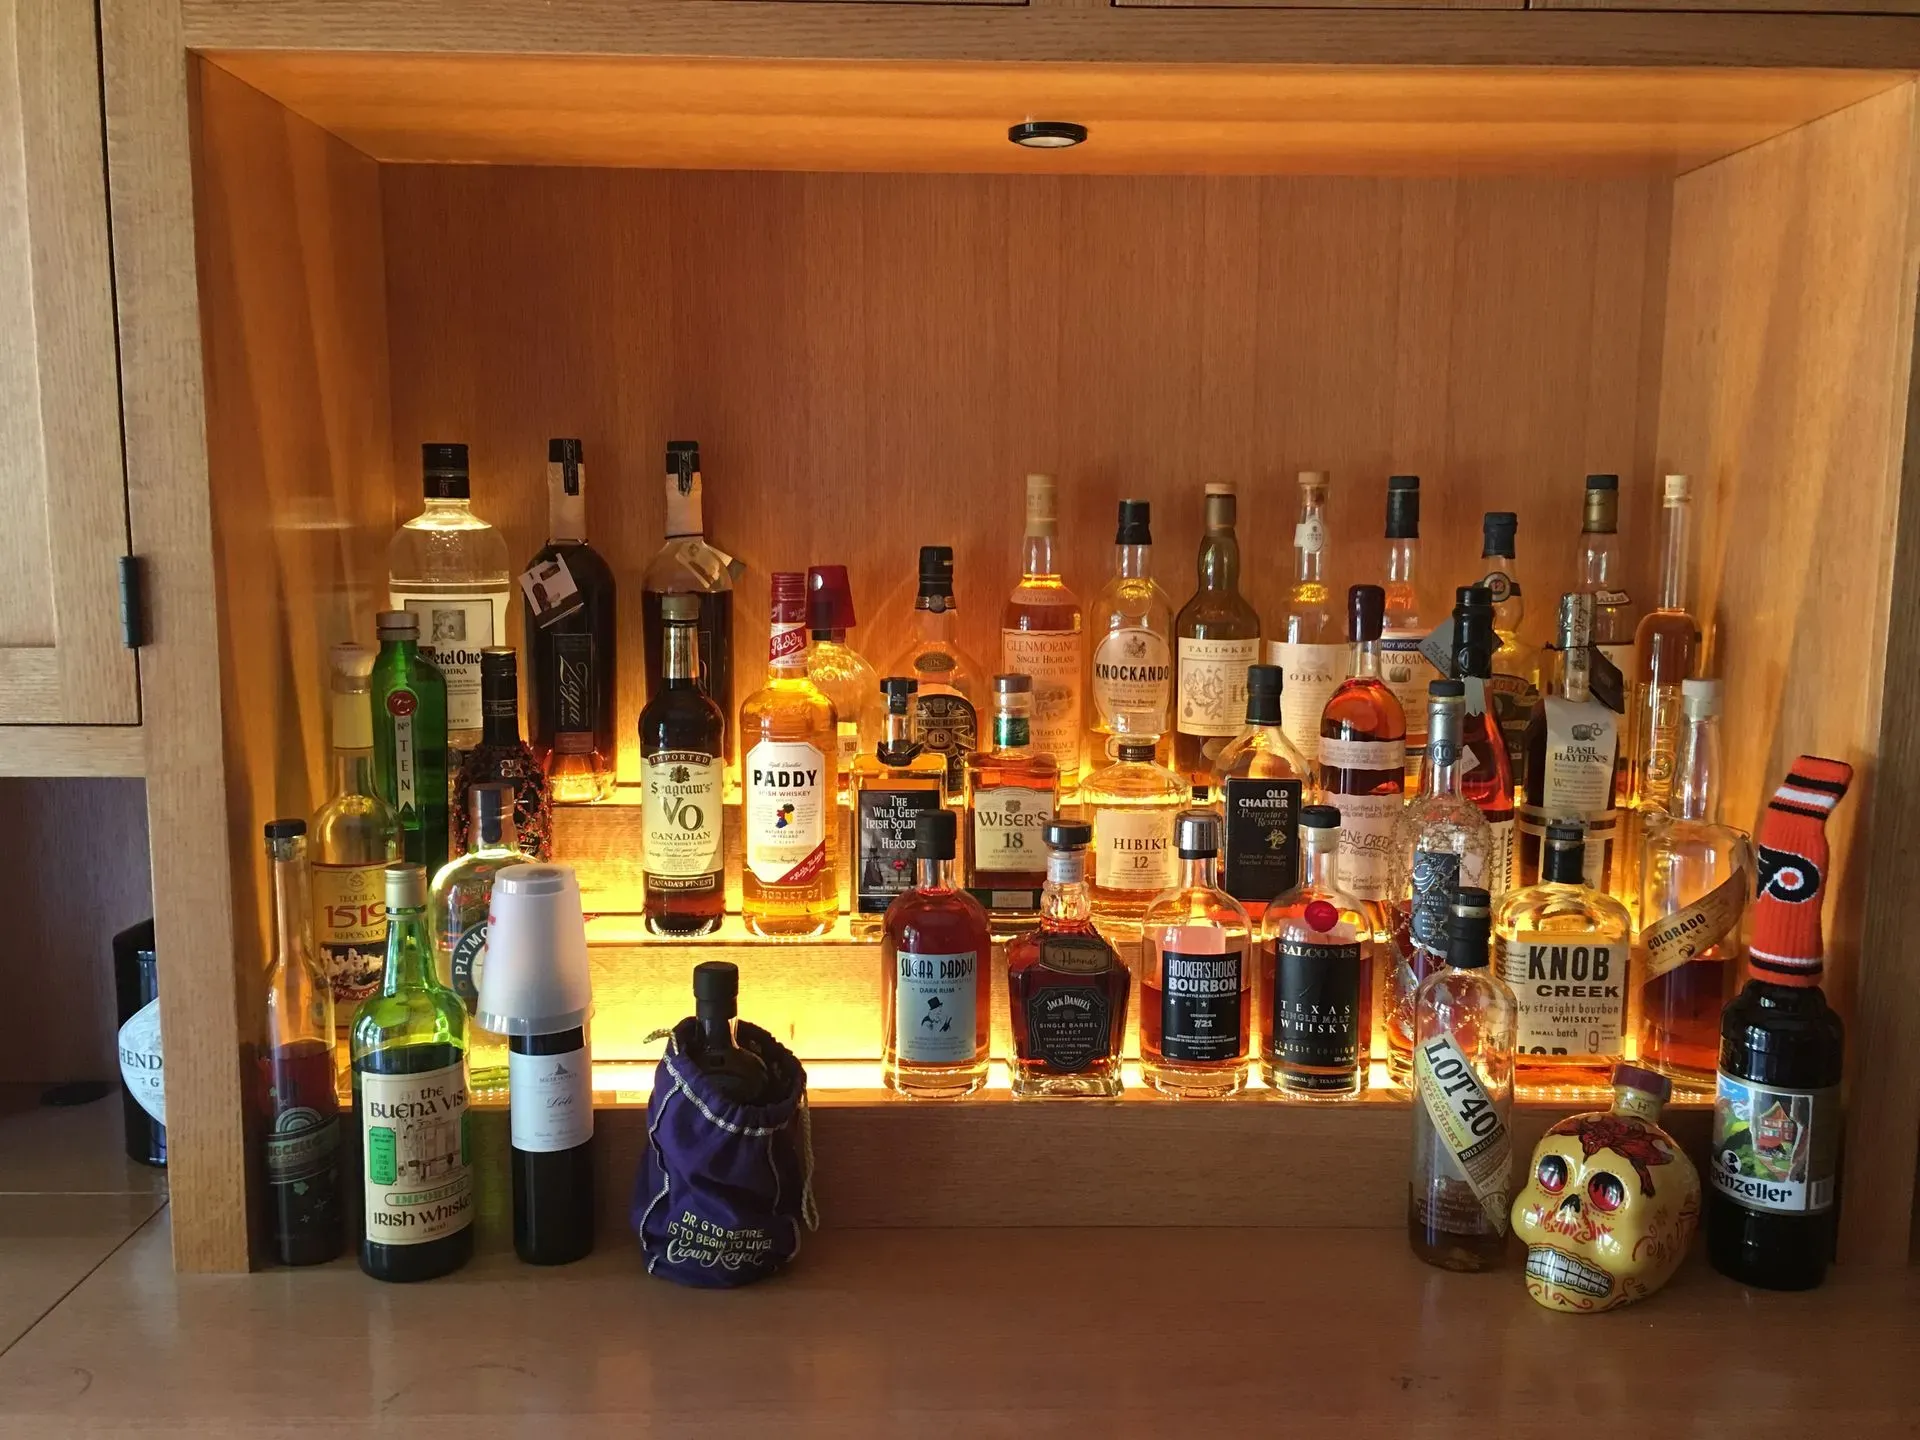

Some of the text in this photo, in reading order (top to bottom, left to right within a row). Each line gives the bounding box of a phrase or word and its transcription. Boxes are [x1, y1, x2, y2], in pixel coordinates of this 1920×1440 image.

[770, 631, 804, 656] Paddy
[1187, 645, 1254, 654] TALISKER
[456, 650, 480, 665] One
[1016, 654, 1040, 664] SINGLE
[1028, 666, 1057, 676] SCOTCH
[1095, 663, 1169, 681] KNOCKANDO
[1289, 672, 1333, 682] OBAN
[558, 654, 588, 728] Zaya
[934, 733, 945, 743] 18
[1566, 745, 1598, 755] BASIL
[399, 739, 411, 791] TEN
[651, 752, 709, 764] IMPORTED
[1553, 753, 1609, 763] HAYDEN'S
[753, 769, 818, 788] PADDY
[890, 795, 908, 807] THE
[1266, 789, 1289, 799] OLD
[1238, 798, 1289, 808] CHARTER
[872, 806, 895, 818] WILD
[977, 811, 1049, 827] WISER'S
[1236, 808, 1288, 819] Proprietor's
[865, 817, 916, 830] IRISH SOLDI
[1254, 817, 1288, 827] Reserve
[650, 831, 712, 841] CANADIAN
[894, 828, 903, 840] &
[1002, 832, 1024, 849] 18
[881, 837, 916, 850] HEROES
[1113, 837, 1168, 850] HIBIKI
[1132, 856, 1149, 869] 12
[650, 878, 713, 888] CANADA'S FINEST
[339, 893, 377, 903] TEQUILA
[755, 889, 802, 900] PRODUCT
[334, 928, 385, 940] REPOSADO
[1647, 912, 1708, 952] COLORADO
[1278, 943, 1358, 960] BALCONES
[901, 957, 974, 979] SUGAR DADDY
[1168, 959, 1238, 979] HOOKER'S HOUSE
[1528, 945, 1610, 981] KNOB
[1168, 977, 1237, 993] BOURBON
[1536, 984, 1620, 998] CREEK
[1046, 994, 1091, 1012] JACK DANIEL'S
[1280, 1000, 1351, 1015] TEXAS
[1533, 1002, 1575, 1016] straight
[1578, 1001, 1619, 1015] bourbon
[1280, 1010, 1350, 1024] SINGLE MALT
[1551, 1015, 1600, 1024] WHISKEY
[1280, 1018, 1350, 1034] WHISKY
[1556, 1028, 1578, 1038] batch
[1273, 1040, 1311, 1054] CLASSIC
[1588, 1030, 1599, 1054] 9
[420, 1086, 444, 1100] the
[1423, 1037, 1478, 1098] LOT
[1459, 1097, 1499, 1137] 40
[1433, 1099, 1465, 1150] WHISKY
[1460, 1146, 1478, 1161] 2012
[1711, 1168, 1793, 1203] penzeller
[682, 1210, 765, 1240] DR. G TO RETIRE
[667, 1220, 773, 1250] IS TO BEGIN TO LIVE!
[666, 1238, 764, 1271] Crown Royal
